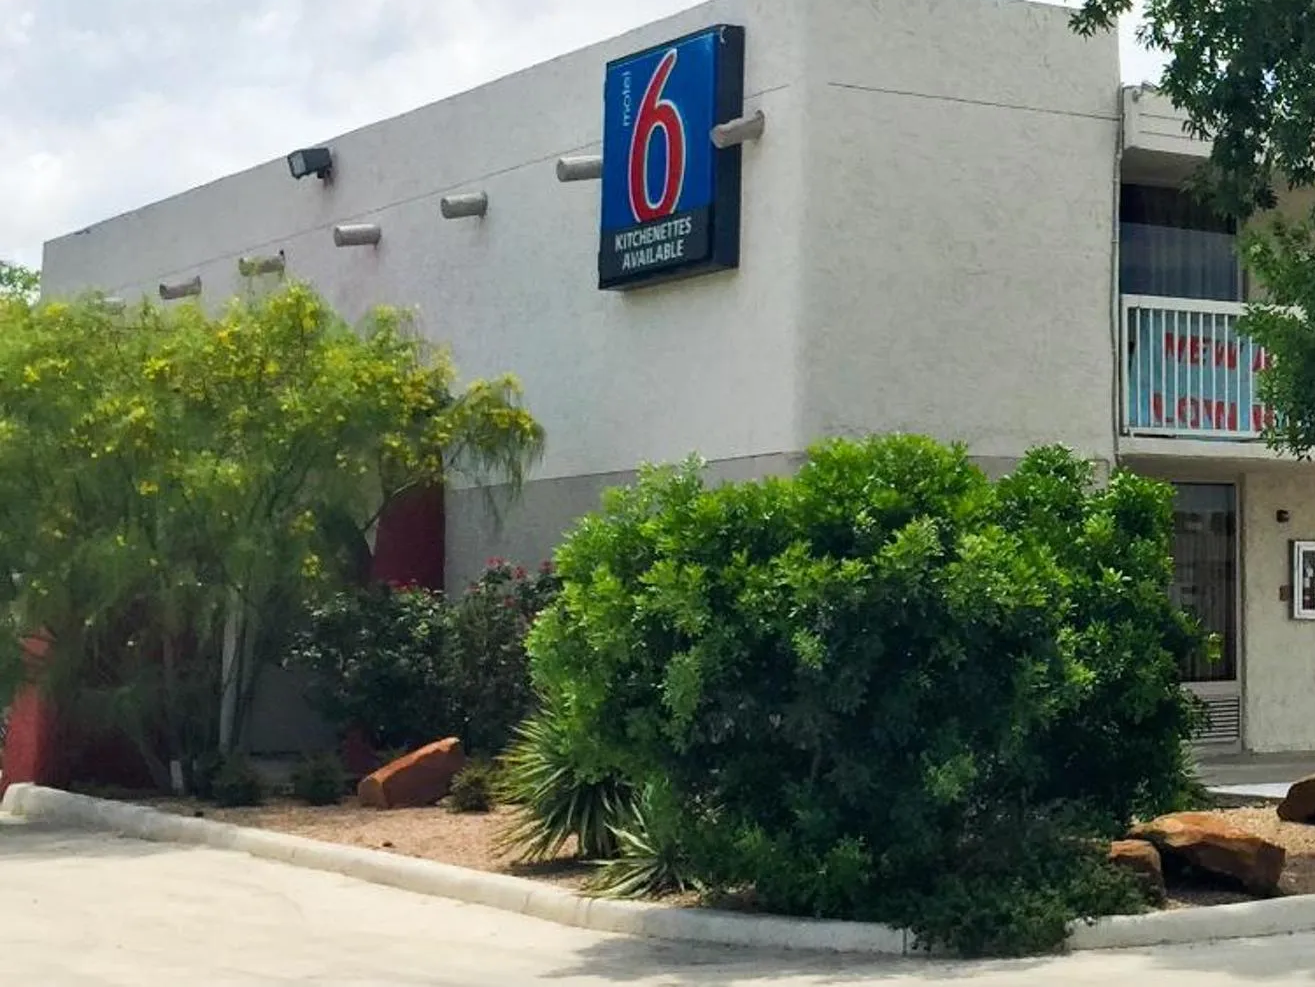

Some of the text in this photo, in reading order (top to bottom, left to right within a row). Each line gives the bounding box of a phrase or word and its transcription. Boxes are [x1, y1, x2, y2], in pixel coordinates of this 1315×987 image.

[622, 70, 632, 127] motel
[628, 48, 687, 223] 6
[614, 216, 692, 253] KITCHENETTES
[622, 241, 684, 271] AVAILABLE
[1163, 332, 1241, 370] NEW
